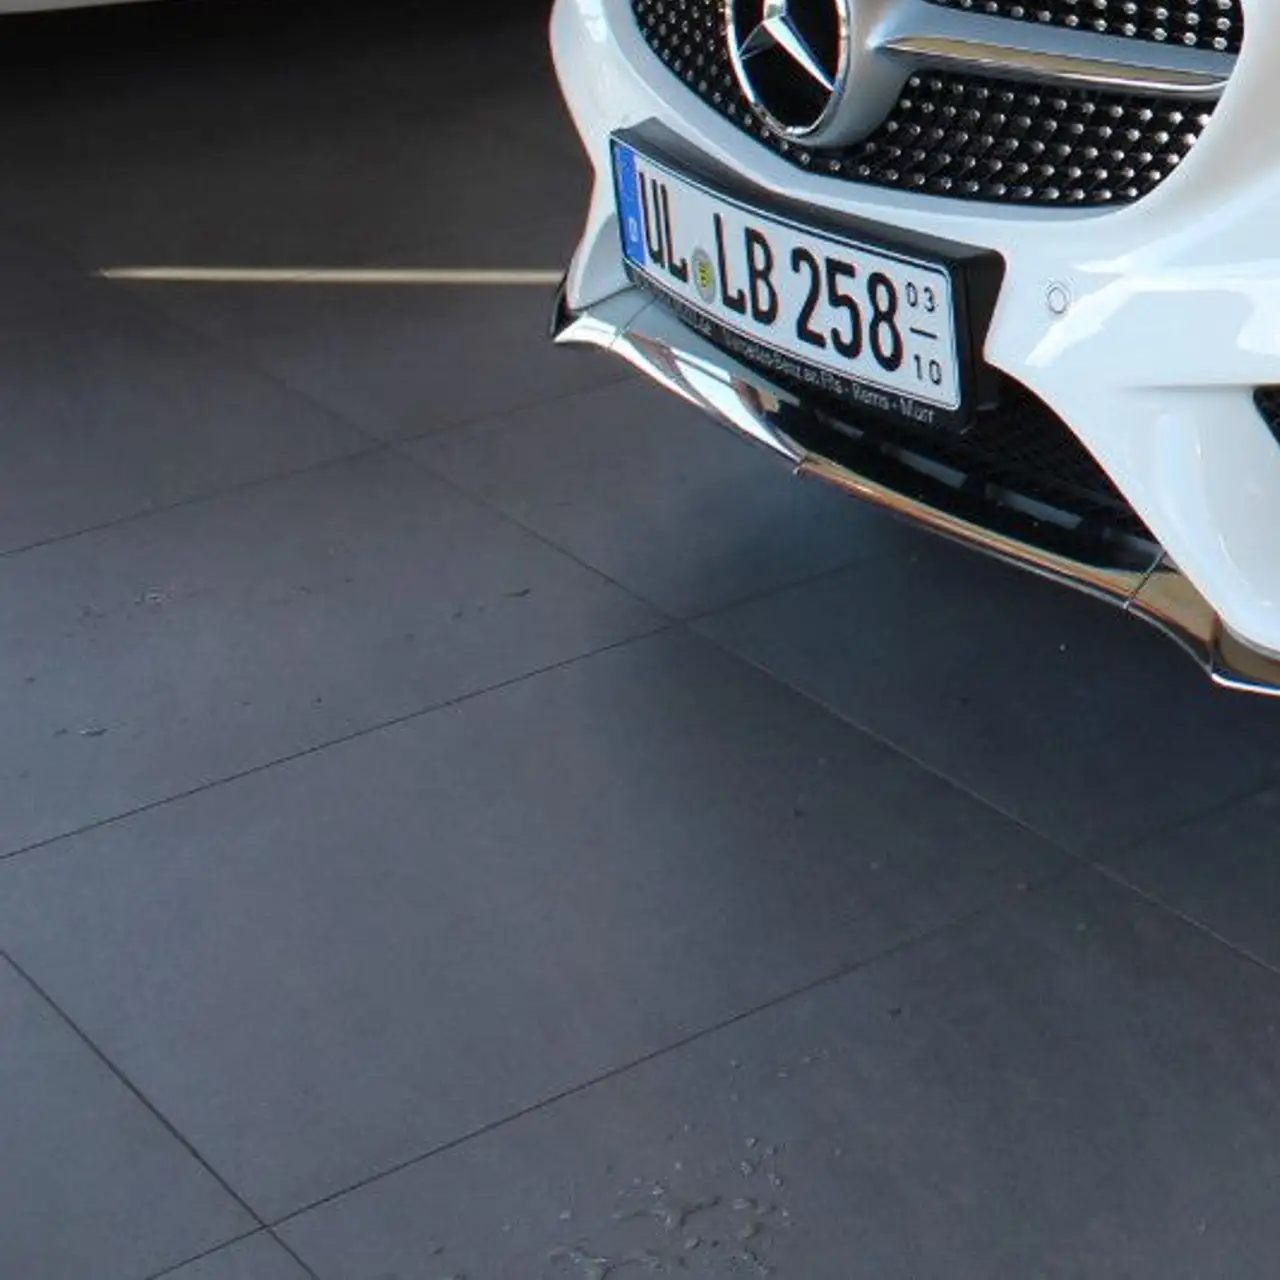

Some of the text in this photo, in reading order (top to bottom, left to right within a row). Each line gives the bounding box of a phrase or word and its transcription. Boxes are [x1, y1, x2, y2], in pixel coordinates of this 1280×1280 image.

[639, 171, 689, 283] UL
[712, 212, 779, 326] LB
[790, 246, 904, 372] 258
[905, 281, 936, 313] 03
[913, 353, 942, 386] 10
